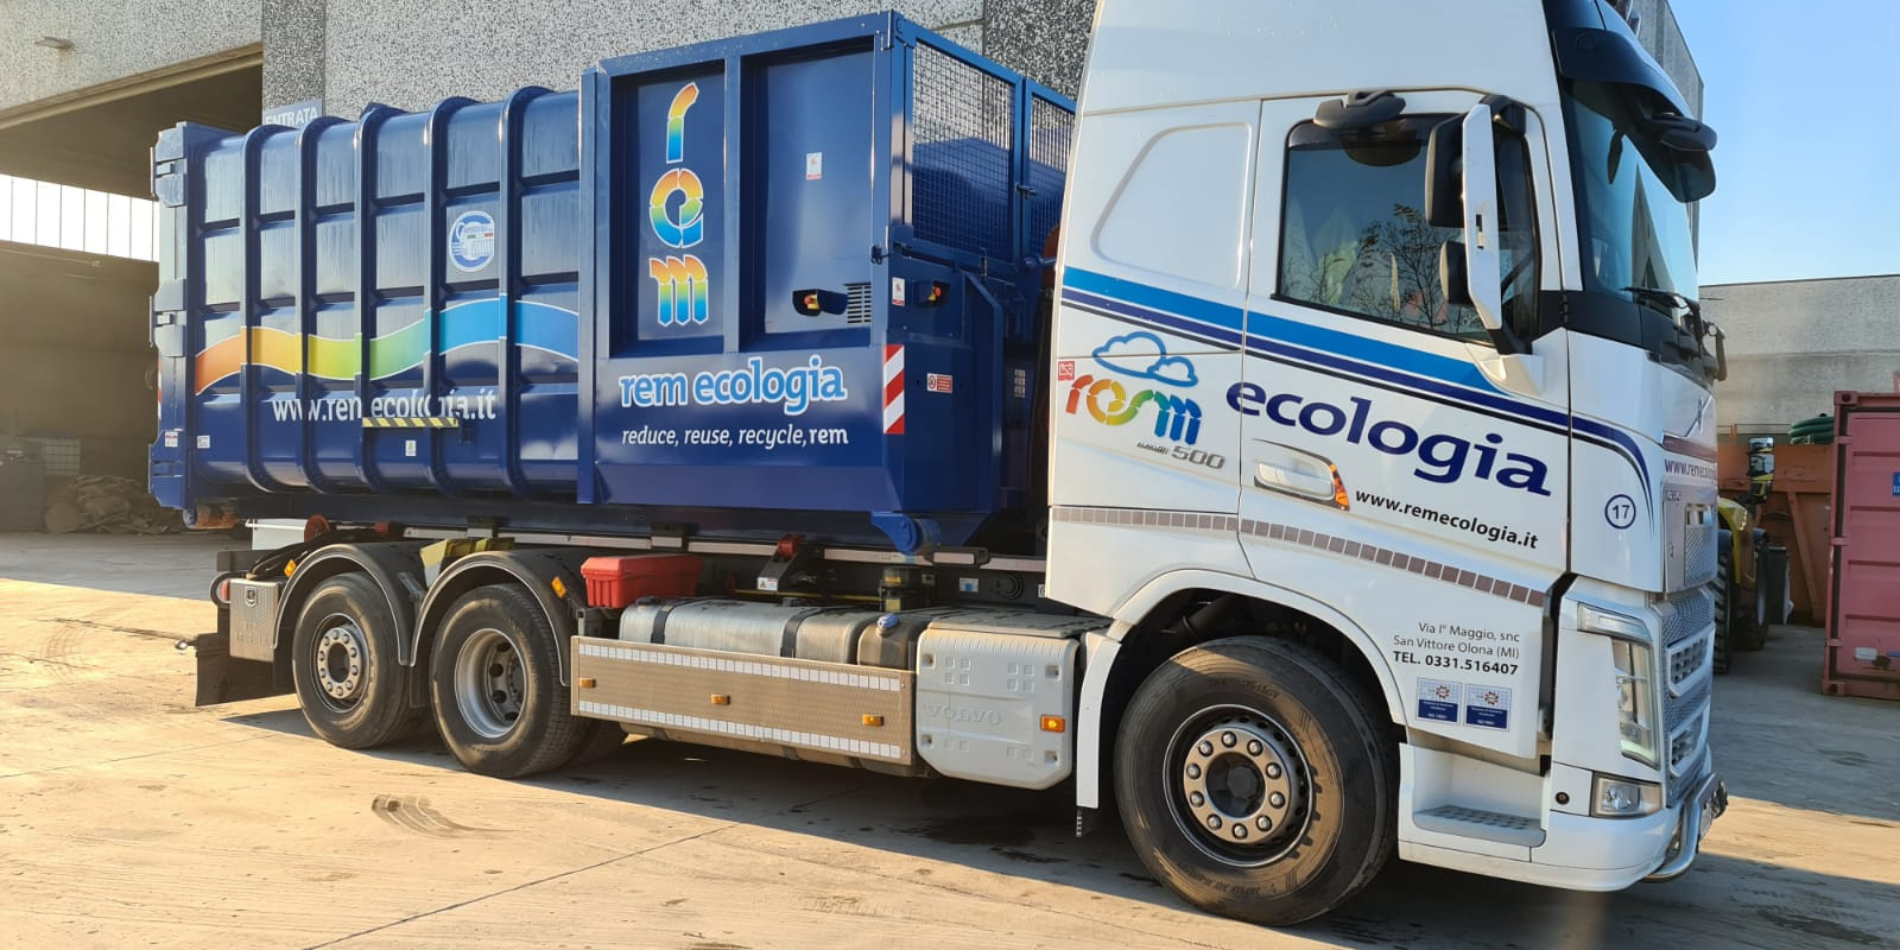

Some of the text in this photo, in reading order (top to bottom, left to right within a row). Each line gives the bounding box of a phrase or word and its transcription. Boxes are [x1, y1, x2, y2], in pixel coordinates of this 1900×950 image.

[265, 106, 318, 126] ENTRATA
[618, 354, 848, 415] rem ecologia
[621, 423, 849, 450] reduce, reuse, recycle, rem
[1226, 381, 1552, 497] ecologia
[1171, 445, 1225, 469] 500
[1355, 490, 1539, 549] www.remecologia.it
[1612, 504, 1631, 520] 17
[1418, 621, 1436, 634] Via
[1449, 625, 1497, 641] Maggio,
[1500, 632, 1520, 643] snc
[1393, 634, 1520, 660] San Vittore Olona (MI)
[1393, 650, 1519, 676] TEL. 0331.516407
[928, 704, 1002, 726] VOLVO
